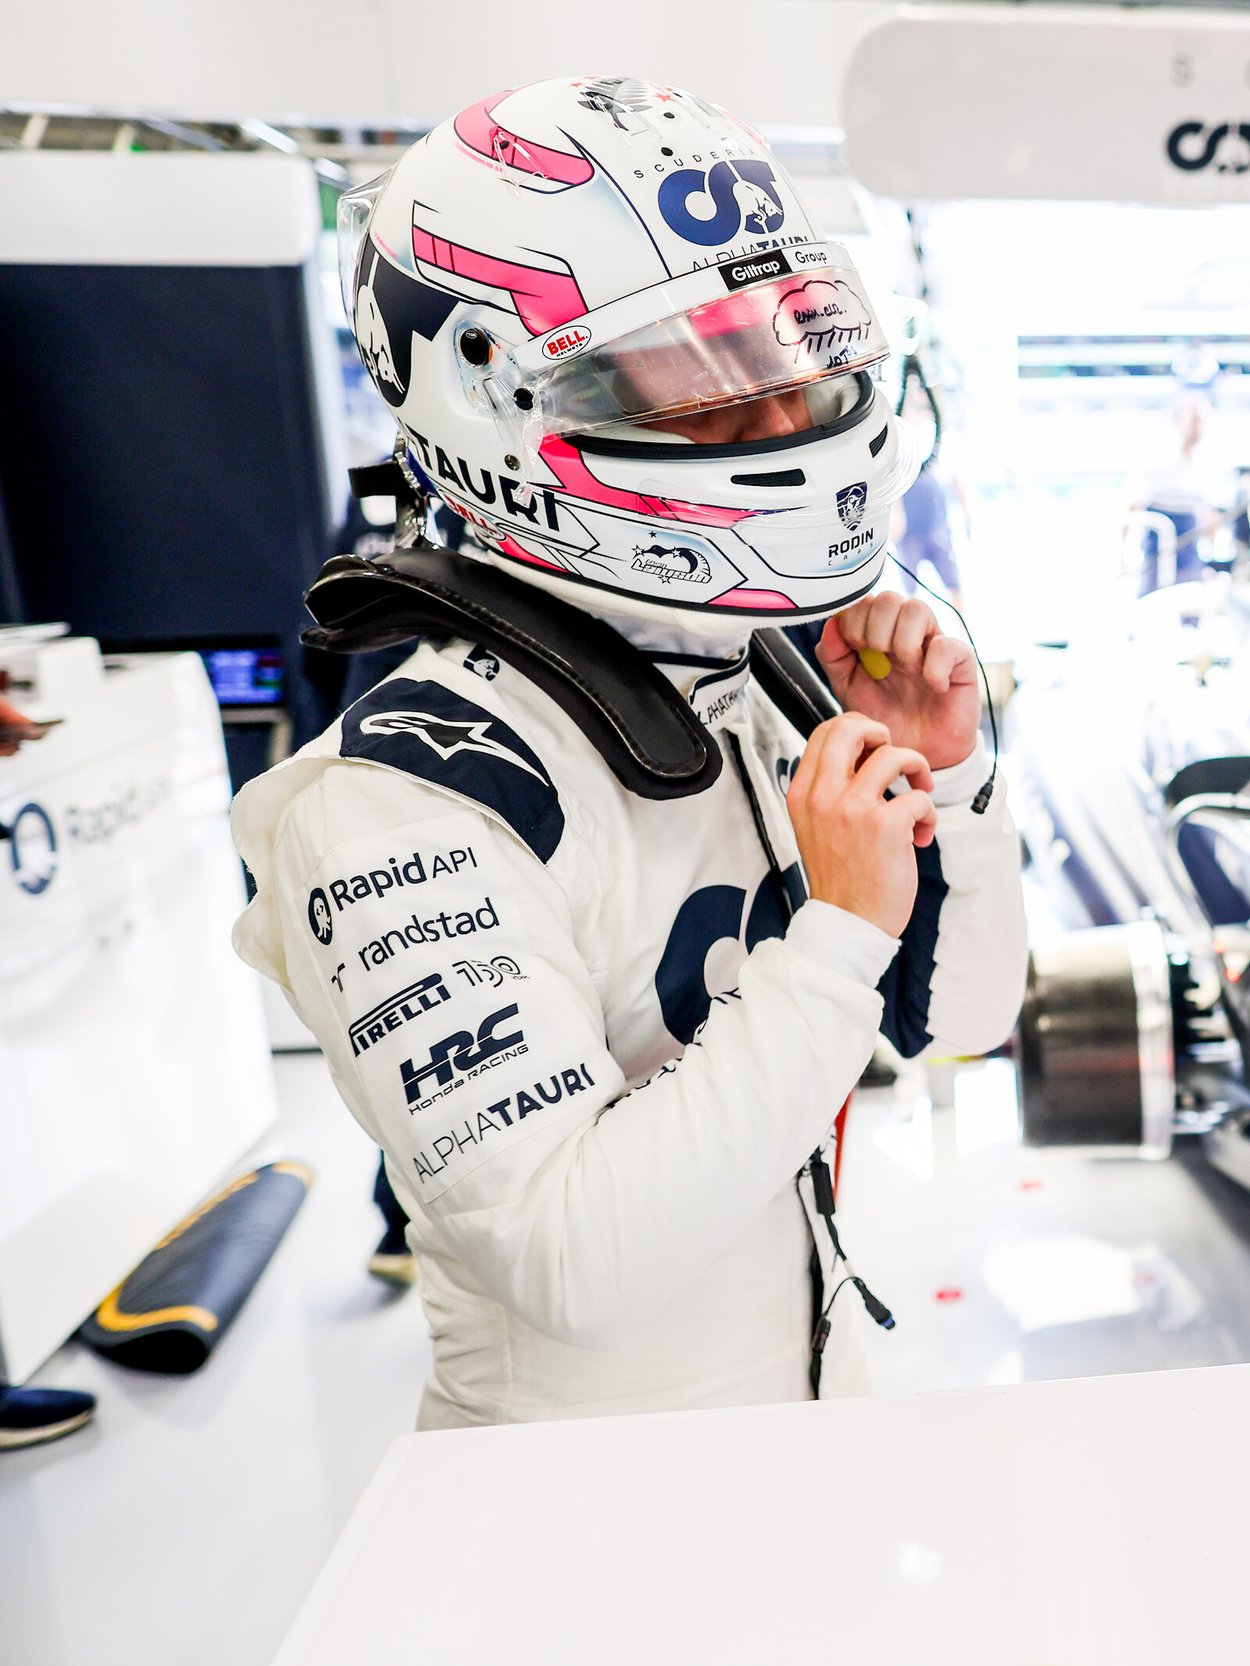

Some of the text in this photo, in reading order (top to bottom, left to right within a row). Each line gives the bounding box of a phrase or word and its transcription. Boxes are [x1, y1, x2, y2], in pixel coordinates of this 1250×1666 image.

[633, 148, 755, 178] SCUDERIA
[731, 250, 828, 282] Giltrap Group
[546, 330, 586, 356] BELL
[828, 527, 874, 559] RODIN
[328, 846, 478, 912] Rapid API
[357, 896, 500, 972] randstad
[348, 972, 452, 1058] PIRELLI
[399, 1002, 525, 1105] HRC
[408, 1043, 530, 1116] Honda RACING
[412, 1062, 597, 1184] ALPHATAURI
